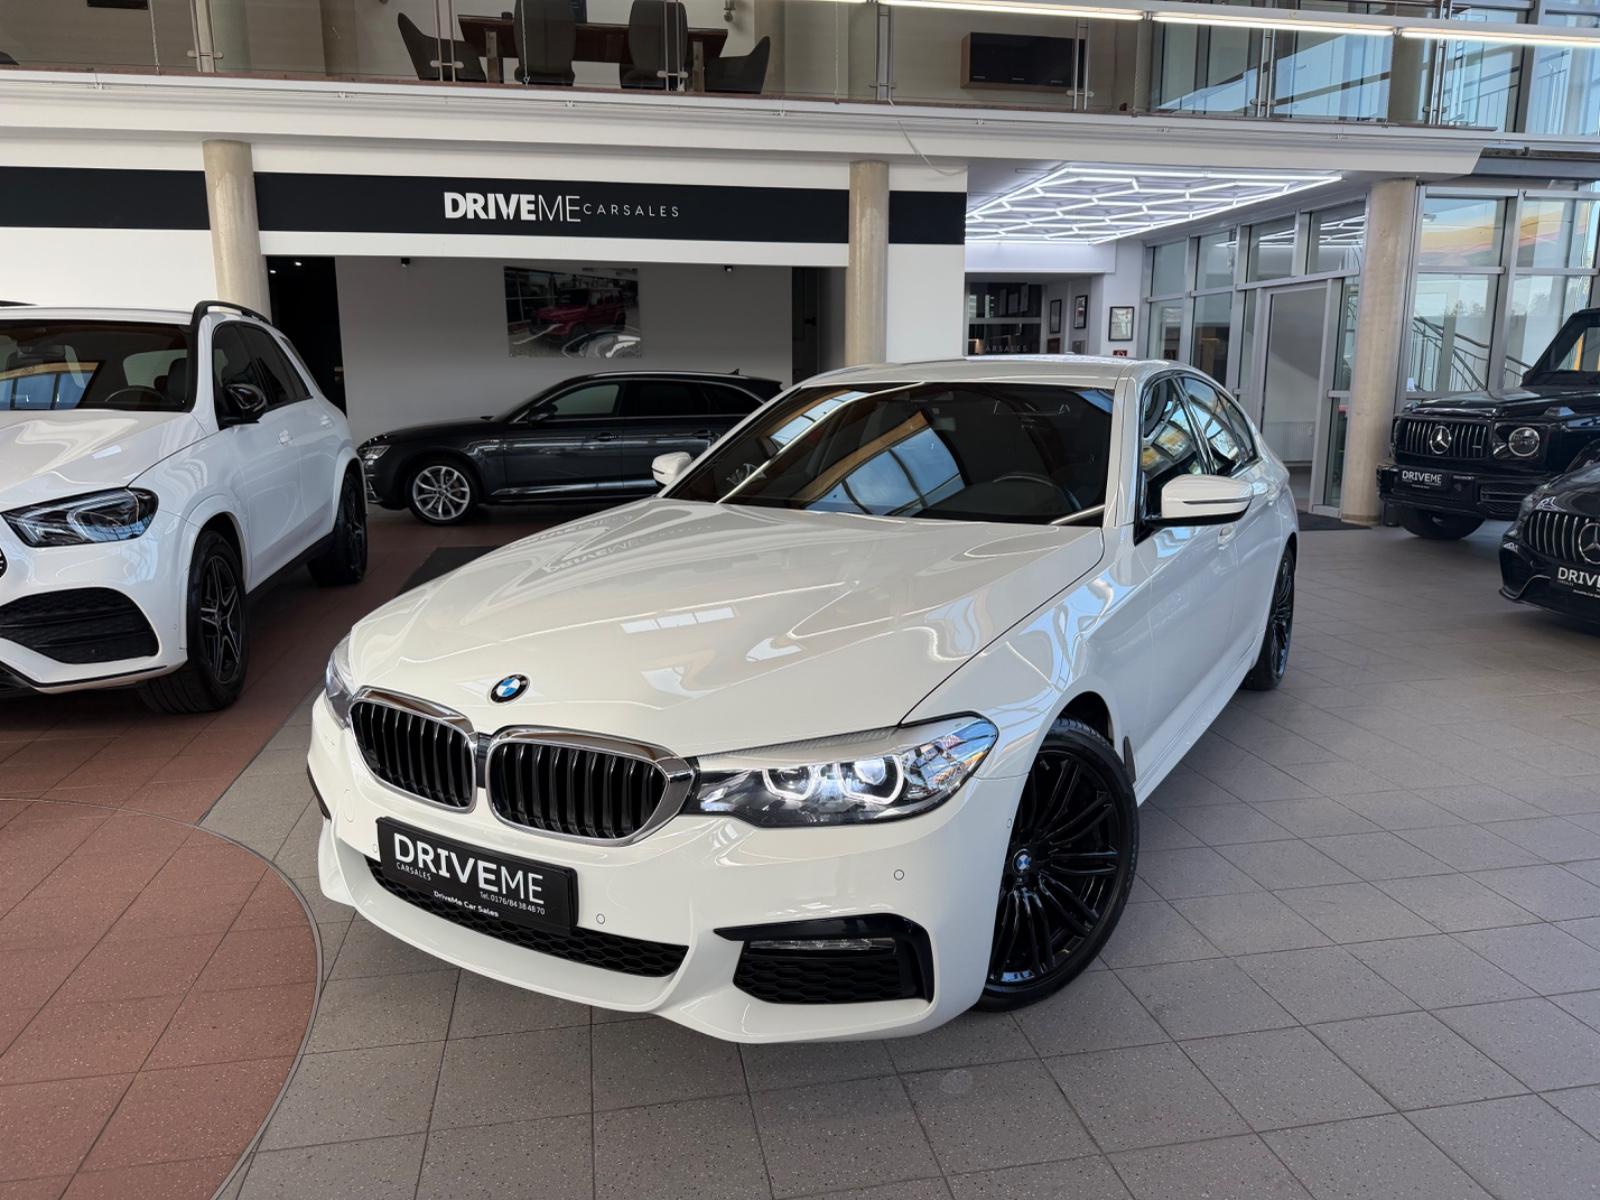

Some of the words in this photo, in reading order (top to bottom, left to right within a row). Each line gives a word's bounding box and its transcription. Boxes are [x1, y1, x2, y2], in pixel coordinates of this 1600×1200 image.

[443, 192, 581, 222] DRIVEME
[583, 203, 679, 217] CARSALES
[1402, 470, 1442, 484] DRIVEME
[393, 832, 545, 905] DRIVEME
[396, 862, 432, 881] CARSALES
[463, 901, 476, 911] Car
[478, 905, 499, 917] Sales
